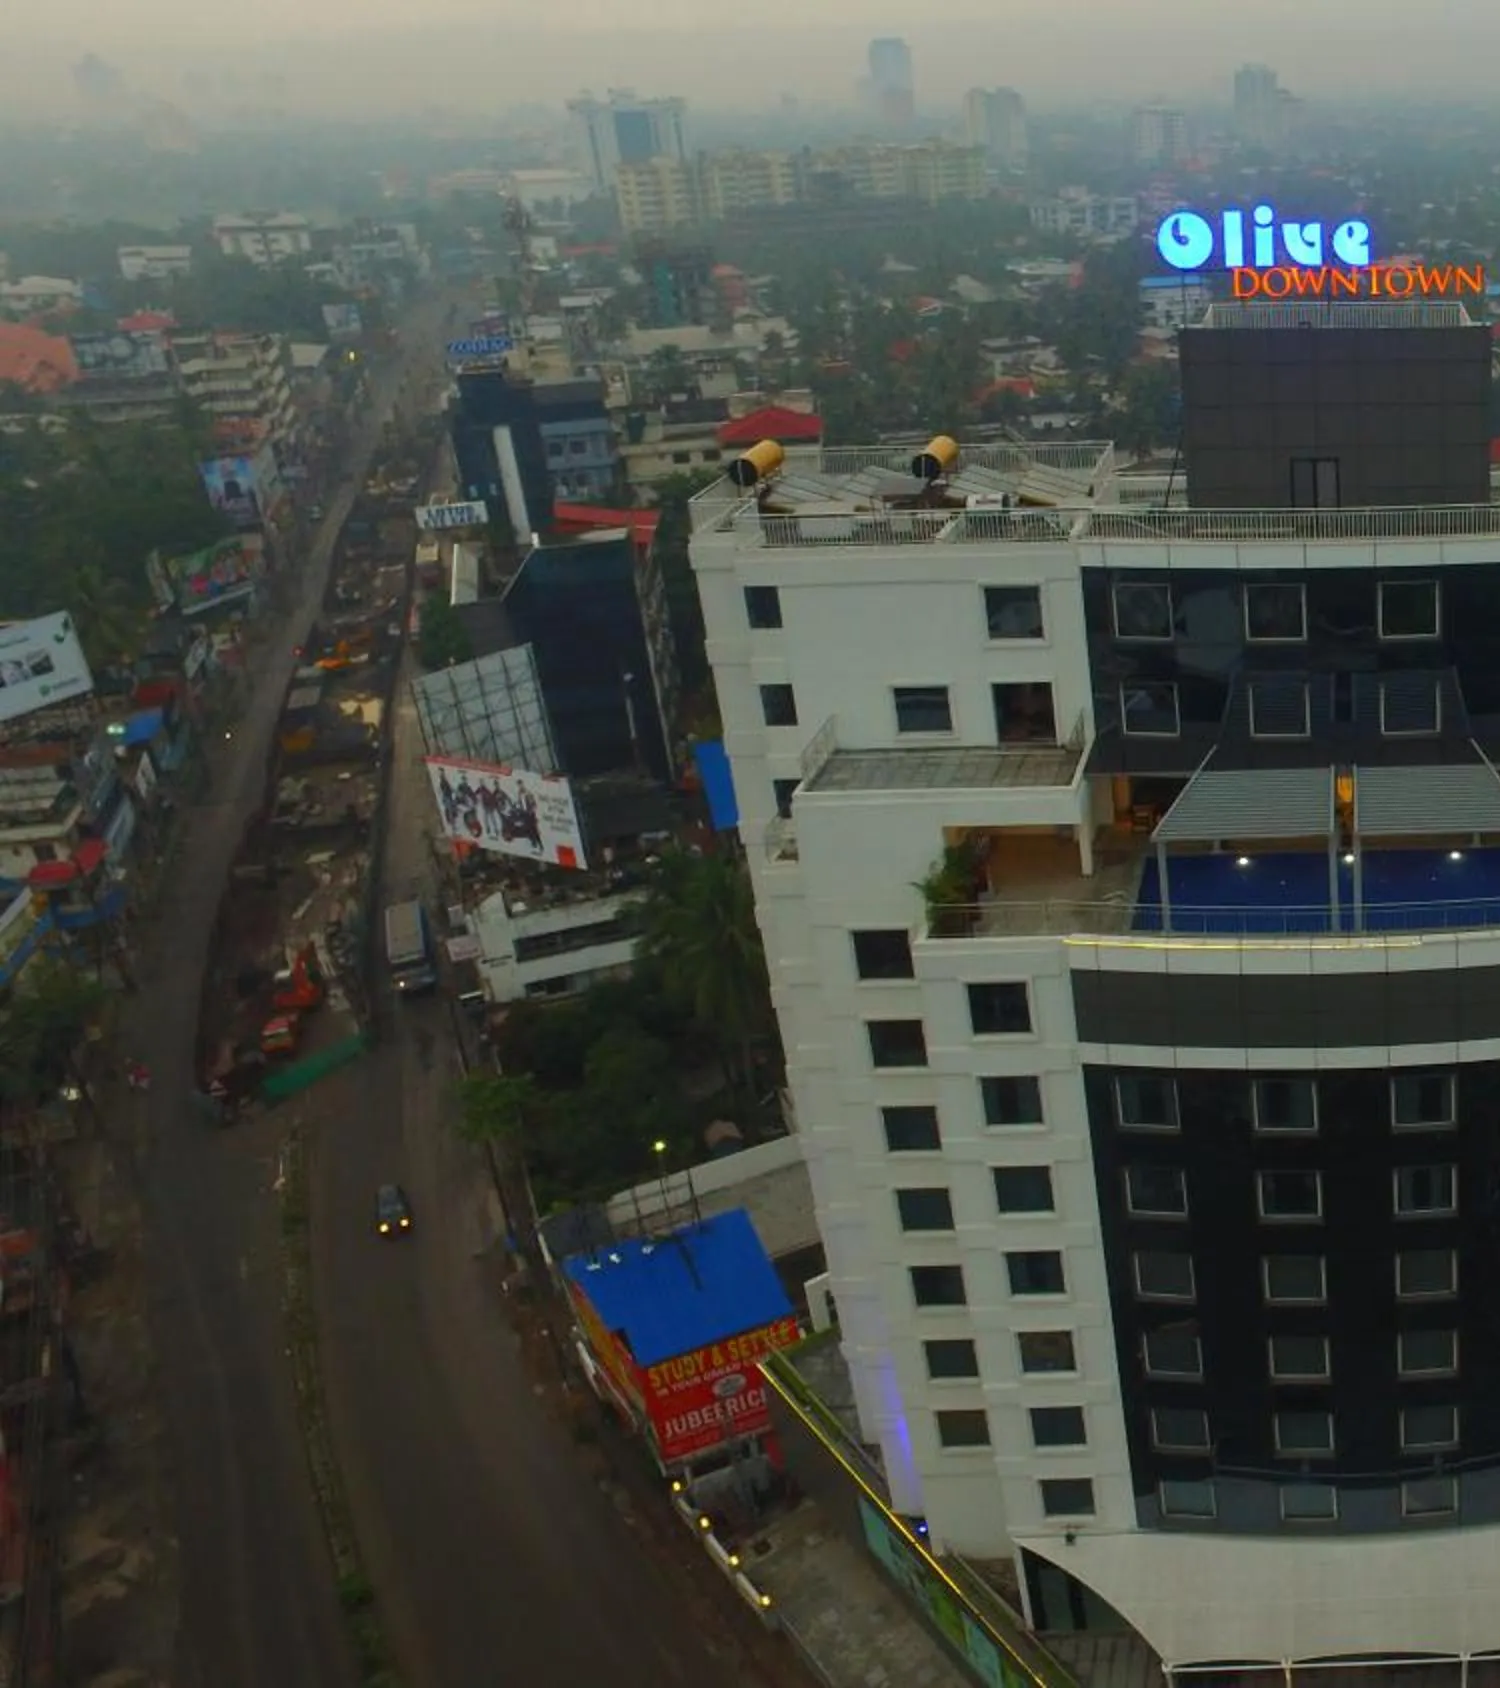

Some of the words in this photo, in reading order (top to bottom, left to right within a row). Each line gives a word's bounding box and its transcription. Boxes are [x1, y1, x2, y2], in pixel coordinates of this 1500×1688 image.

[1156, 204, 1370, 269] Olive
[1232, 264, 1484, 298] DOWNTOWN
[648, 1350, 705, 1388] STUDY
